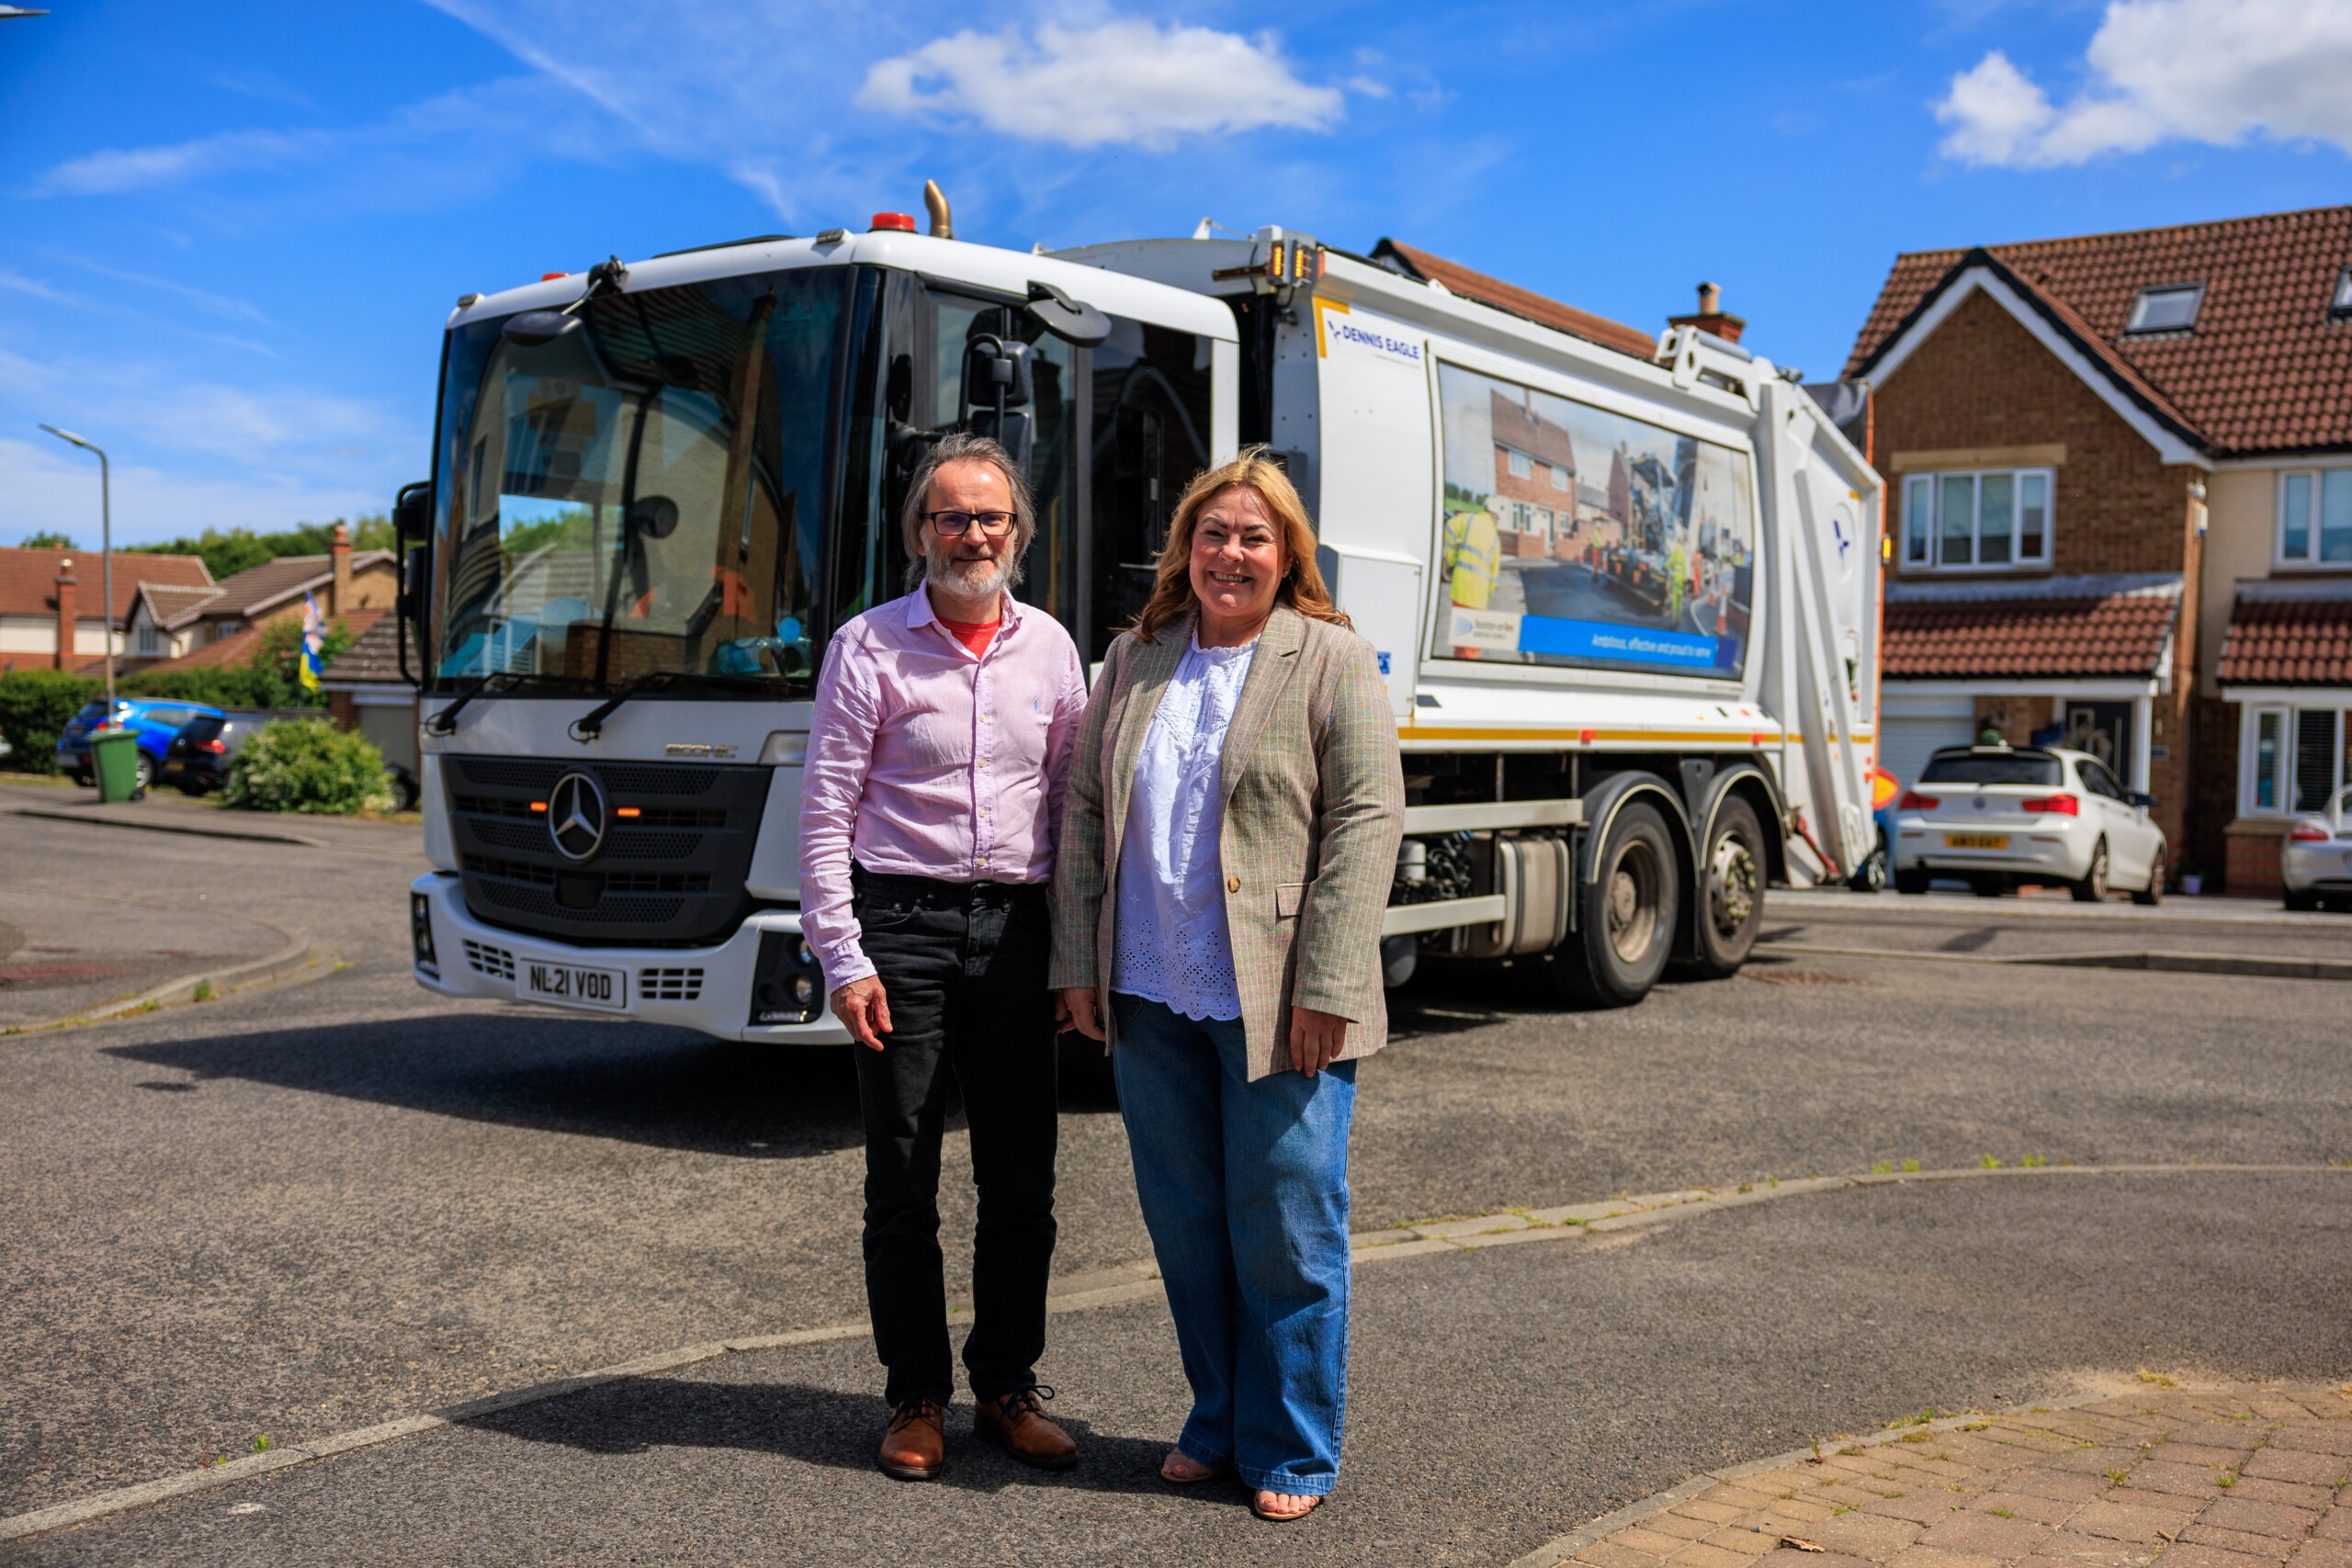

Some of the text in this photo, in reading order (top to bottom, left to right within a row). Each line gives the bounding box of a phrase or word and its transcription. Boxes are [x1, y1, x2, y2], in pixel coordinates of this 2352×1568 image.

[1342, 325, 1419, 359] DENNIS EAGLE
[530, 965, 611, 1000] NL21 VOD
